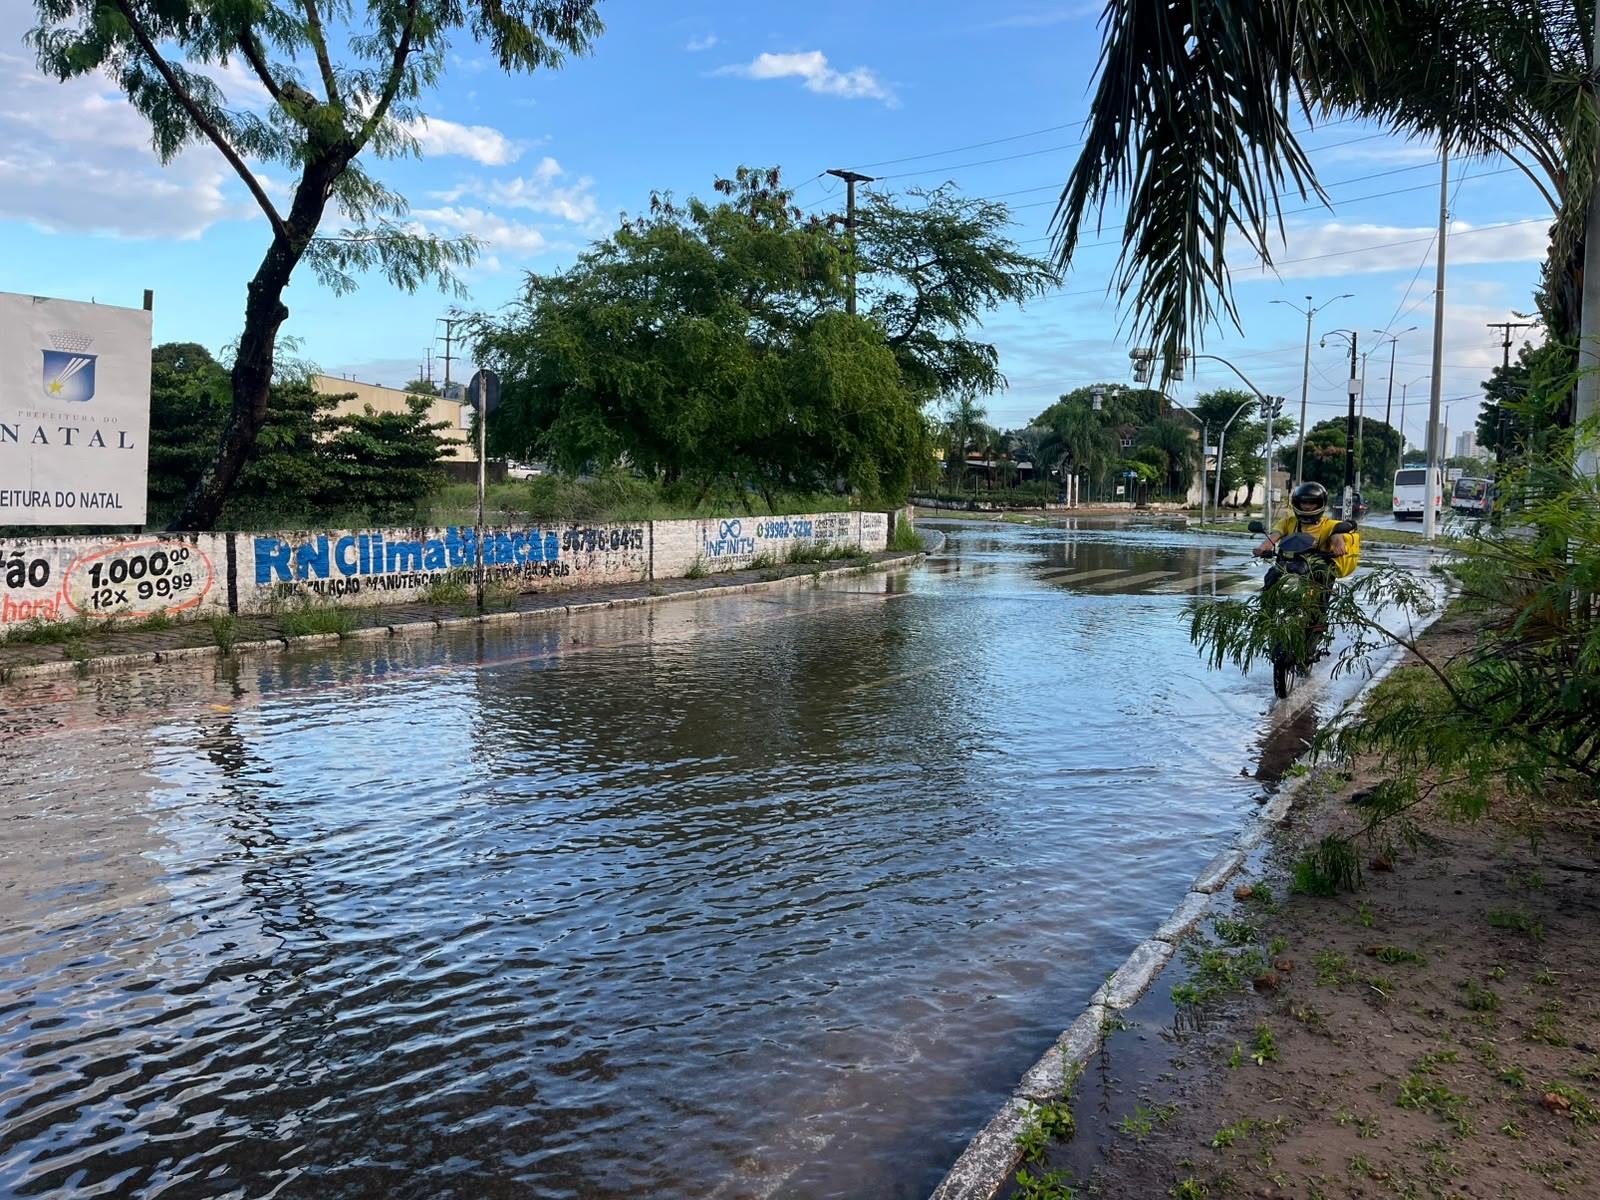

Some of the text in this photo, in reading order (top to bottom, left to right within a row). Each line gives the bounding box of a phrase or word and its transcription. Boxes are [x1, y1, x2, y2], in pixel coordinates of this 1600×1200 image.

[18, 410, 96, 423] PREFEITURA
[0, 423, 135, 449] NATAL
[55, 491, 76, 508] DO
[80, 492, 123, 509] NATAL
[706, 537, 755, 557] INFINITY
